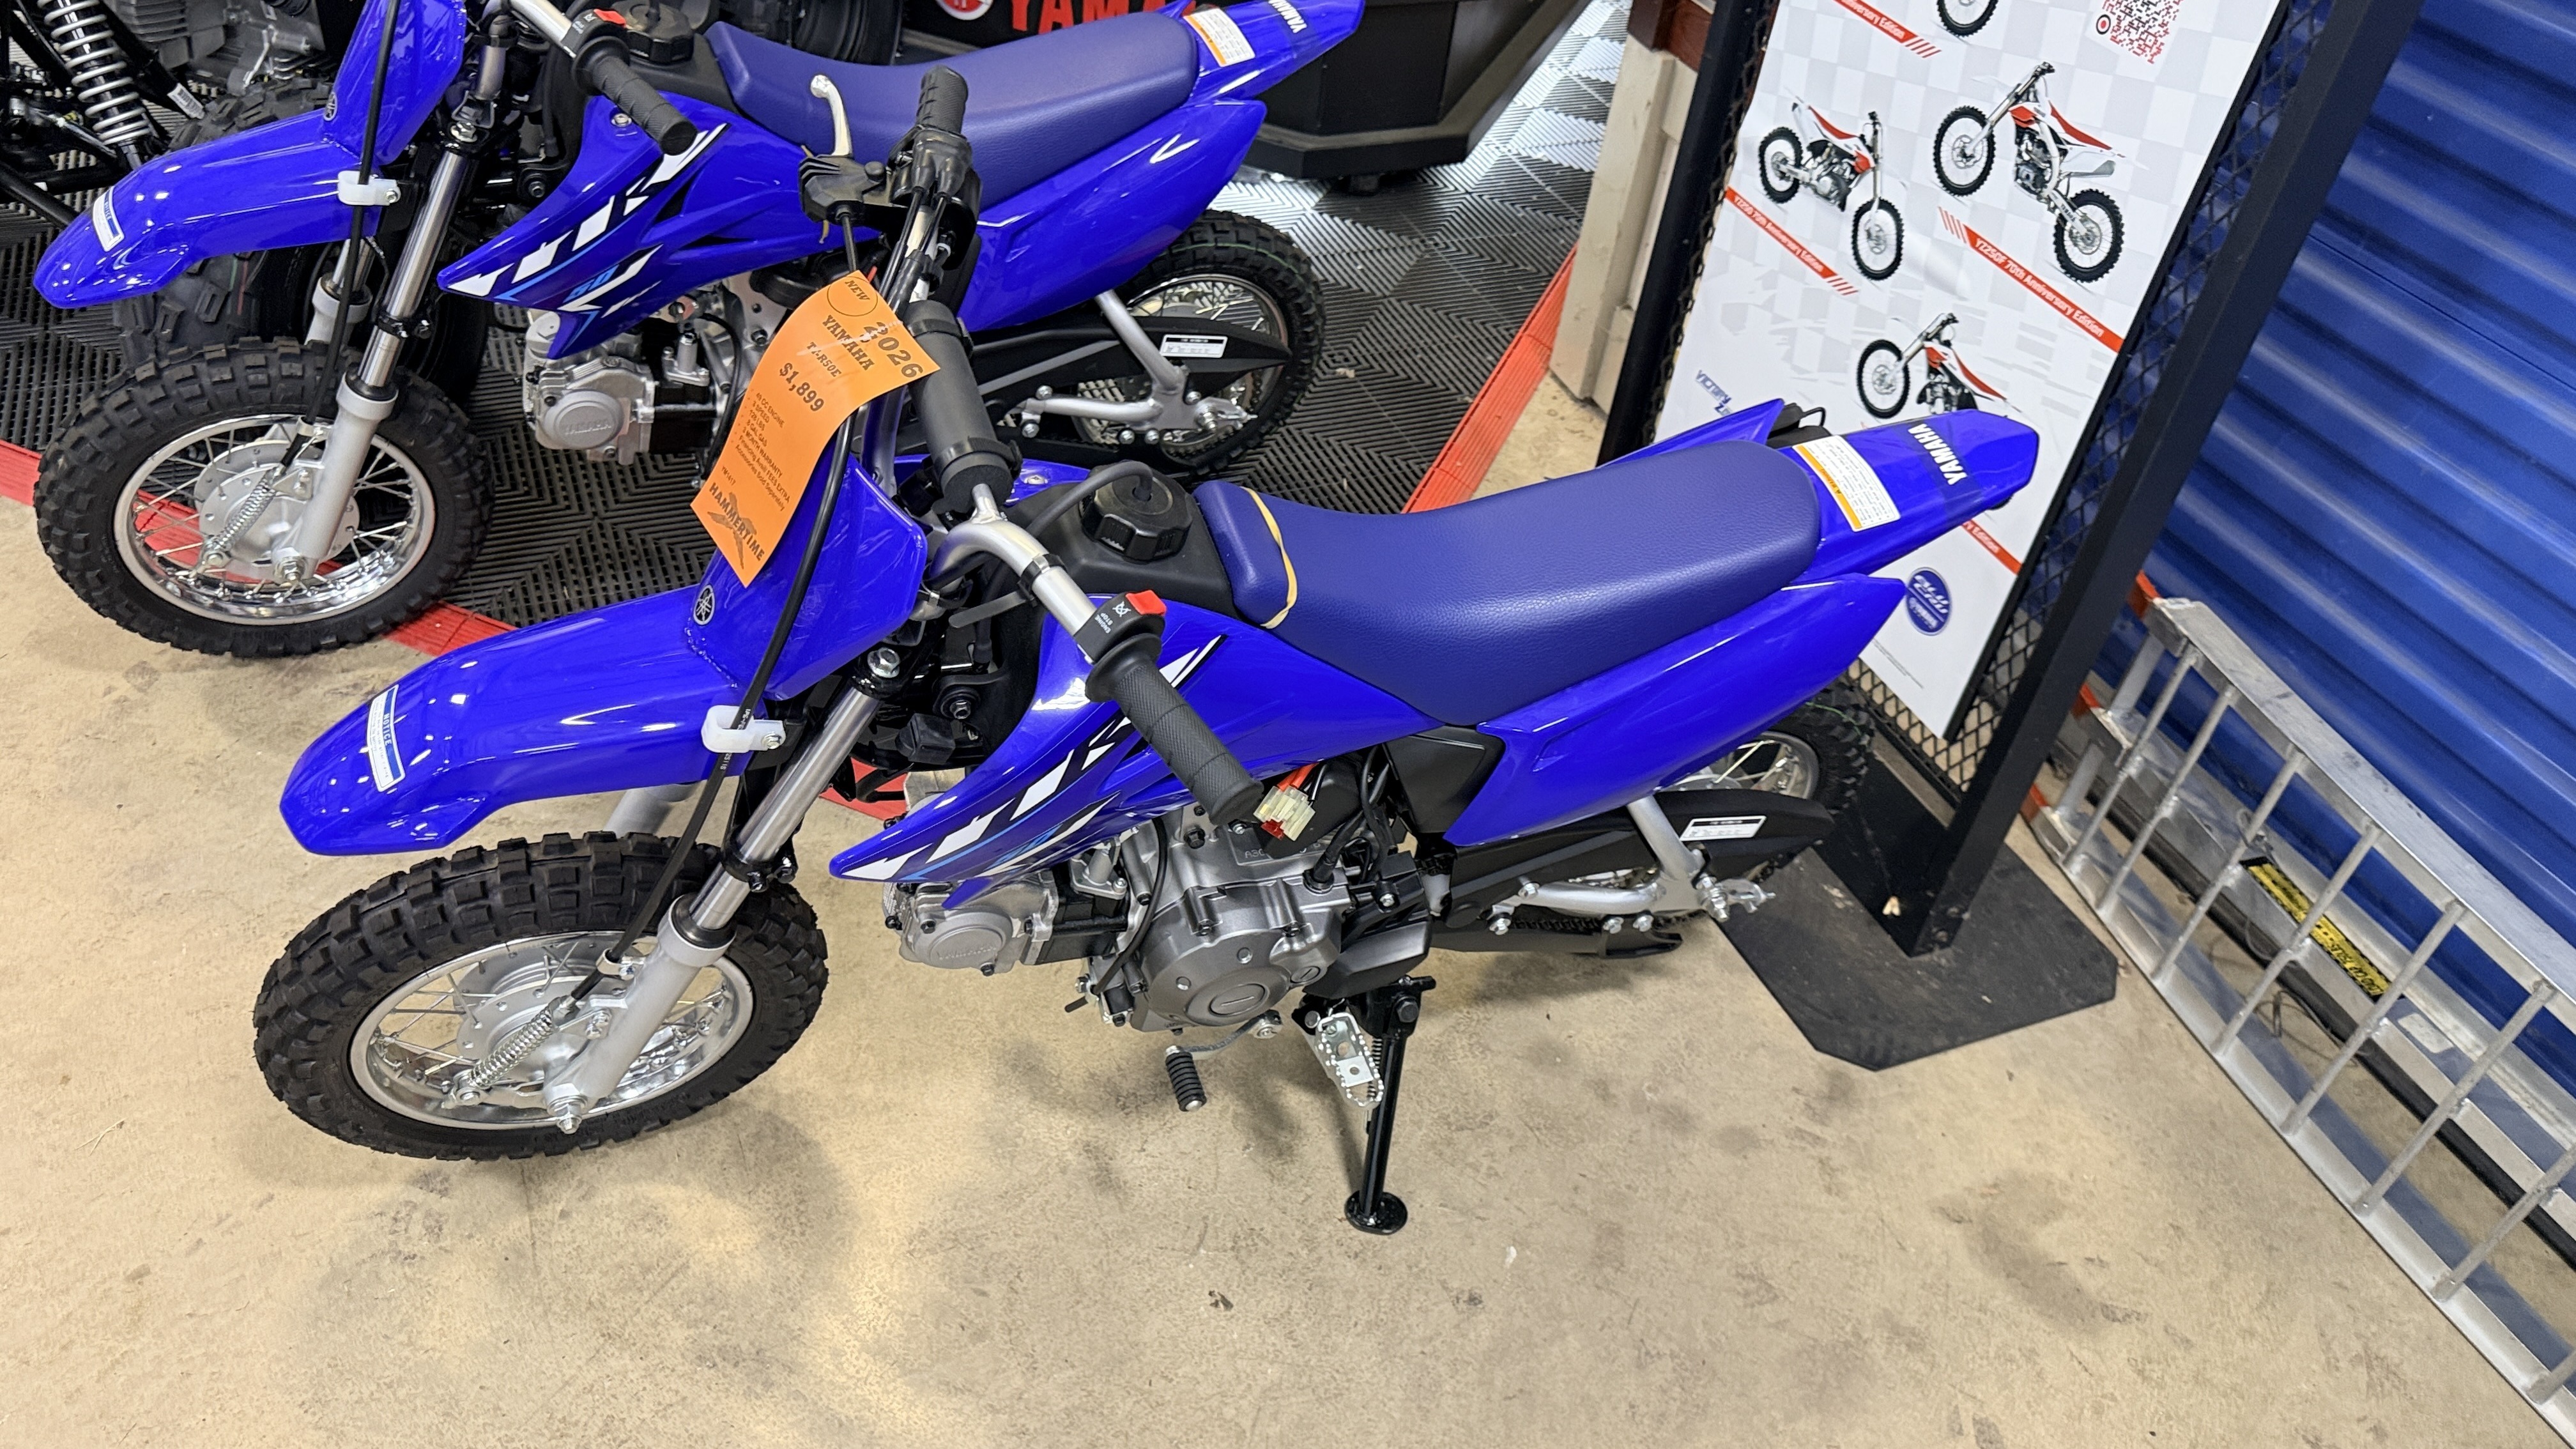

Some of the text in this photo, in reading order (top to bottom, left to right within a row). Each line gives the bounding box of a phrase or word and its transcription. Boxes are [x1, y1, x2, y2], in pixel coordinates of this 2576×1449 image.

[845, 280, 870, 301] NEW
[2023, 275, 2074, 316] Anniversary
[2072, 310, 2104, 337] Edition
[822, 314, 875, 371] YAMAHA
[779, 362, 824, 412] $1,899
[767, 406, 785, 428] ENGINE
[759, 448, 783, 478] WARRANTY
[1908, 424, 1968, 485] YAMAHA
[776, 483, 790, 504] EXTRA
[709, 482, 765, 561] HAMMERTIME
[1094, 614, 1111, 634] ENGINE
[1100, 613, 1114, 626] STOP
[383, 713, 392, 746] NOTICE
